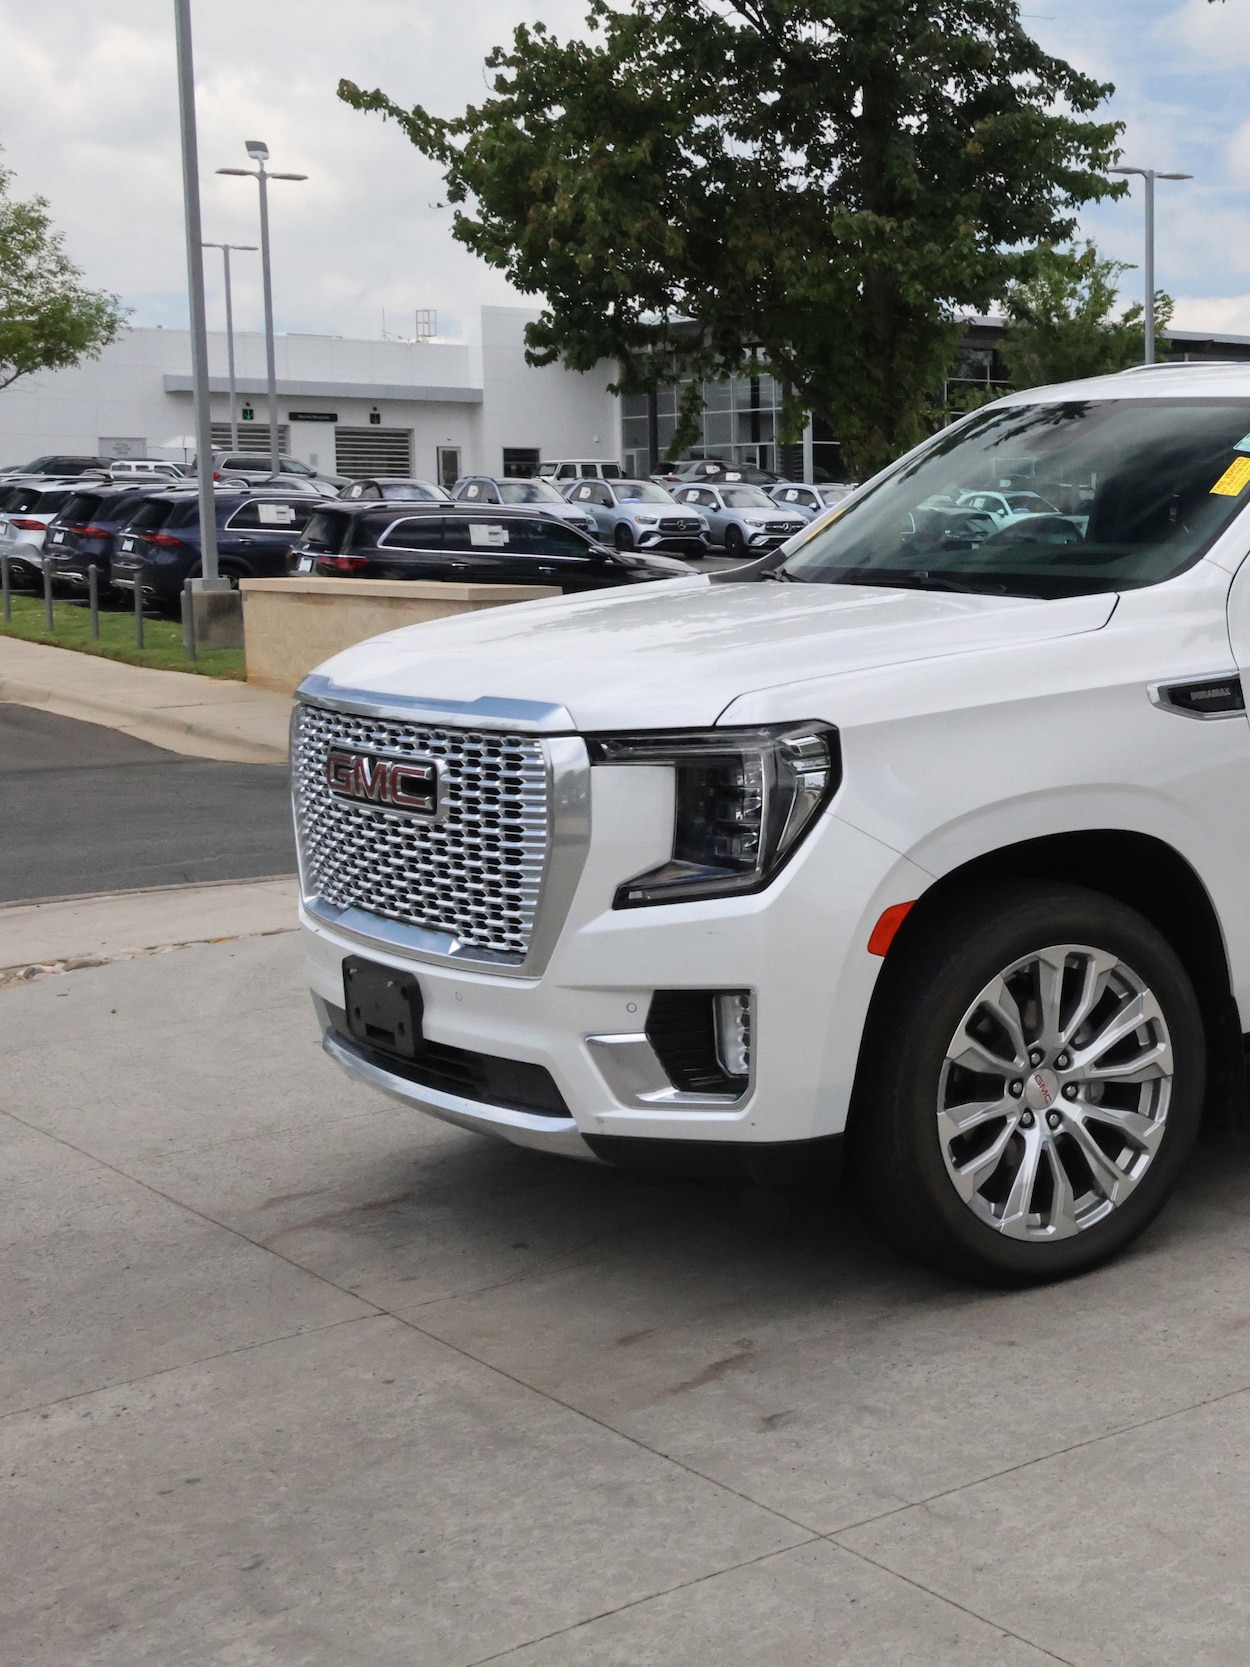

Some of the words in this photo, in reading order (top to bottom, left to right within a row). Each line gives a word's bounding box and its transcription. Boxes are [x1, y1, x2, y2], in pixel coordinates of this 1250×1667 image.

[1190, 687, 1231, 701] DURAMAX
[327, 752, 433, 811] GMC
[1034, 1074, 1052, 1105] GMC
